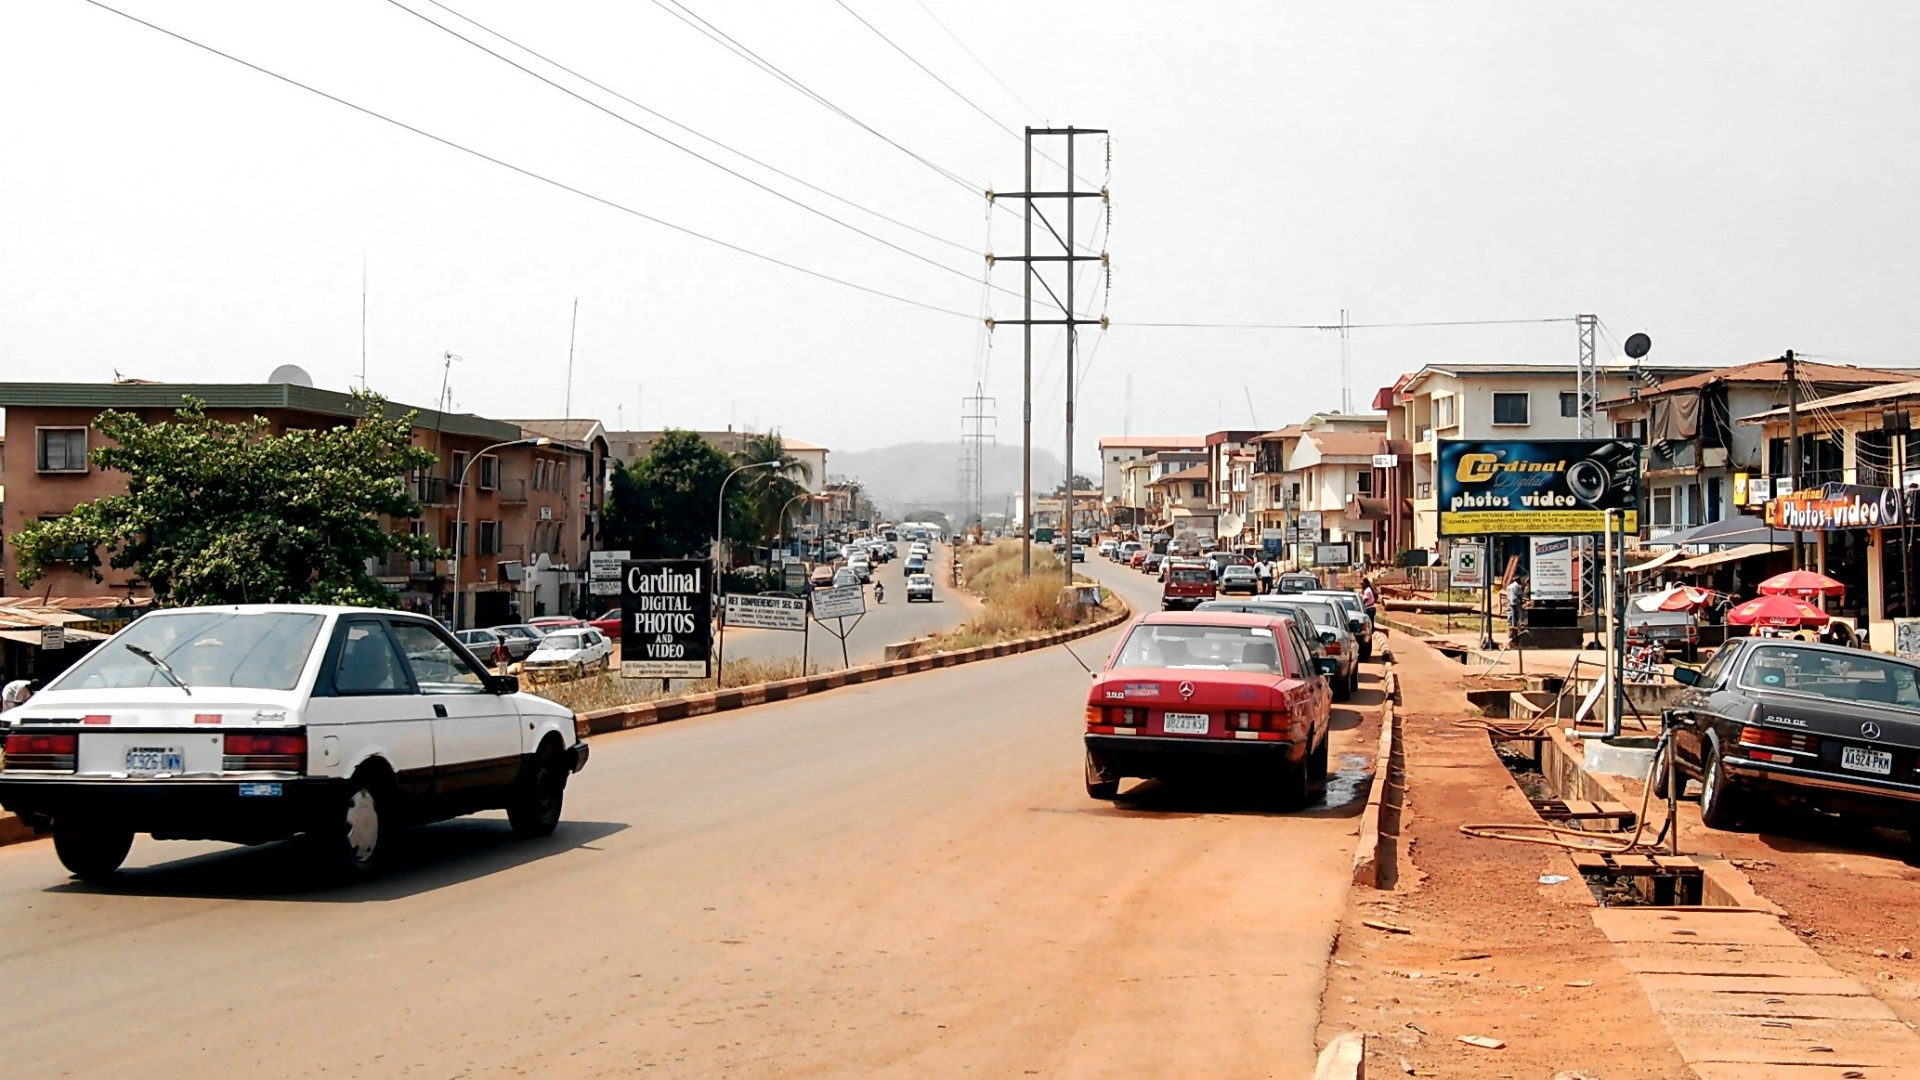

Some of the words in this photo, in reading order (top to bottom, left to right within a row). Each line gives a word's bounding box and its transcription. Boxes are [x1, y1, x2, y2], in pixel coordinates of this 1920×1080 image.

[1455, 453, 1566, 483] Cardinal
[1451, 491, 1510, 513] photos
[1520, 490, 1576, 507] video
[1783, 501, 1825, 527] Photos
[1833, 494, 1879, 526] video
[628, 567, 701, 594] Cardinal
[640, 595, 692, 611] DIGITAL
[634, 613, 695, 634] PHOTOS
[655, 634, 673, 644] AND
[646, 644, 685, 658] VIDEO
[1845, 752, 1890, 770] AA924-PKM
